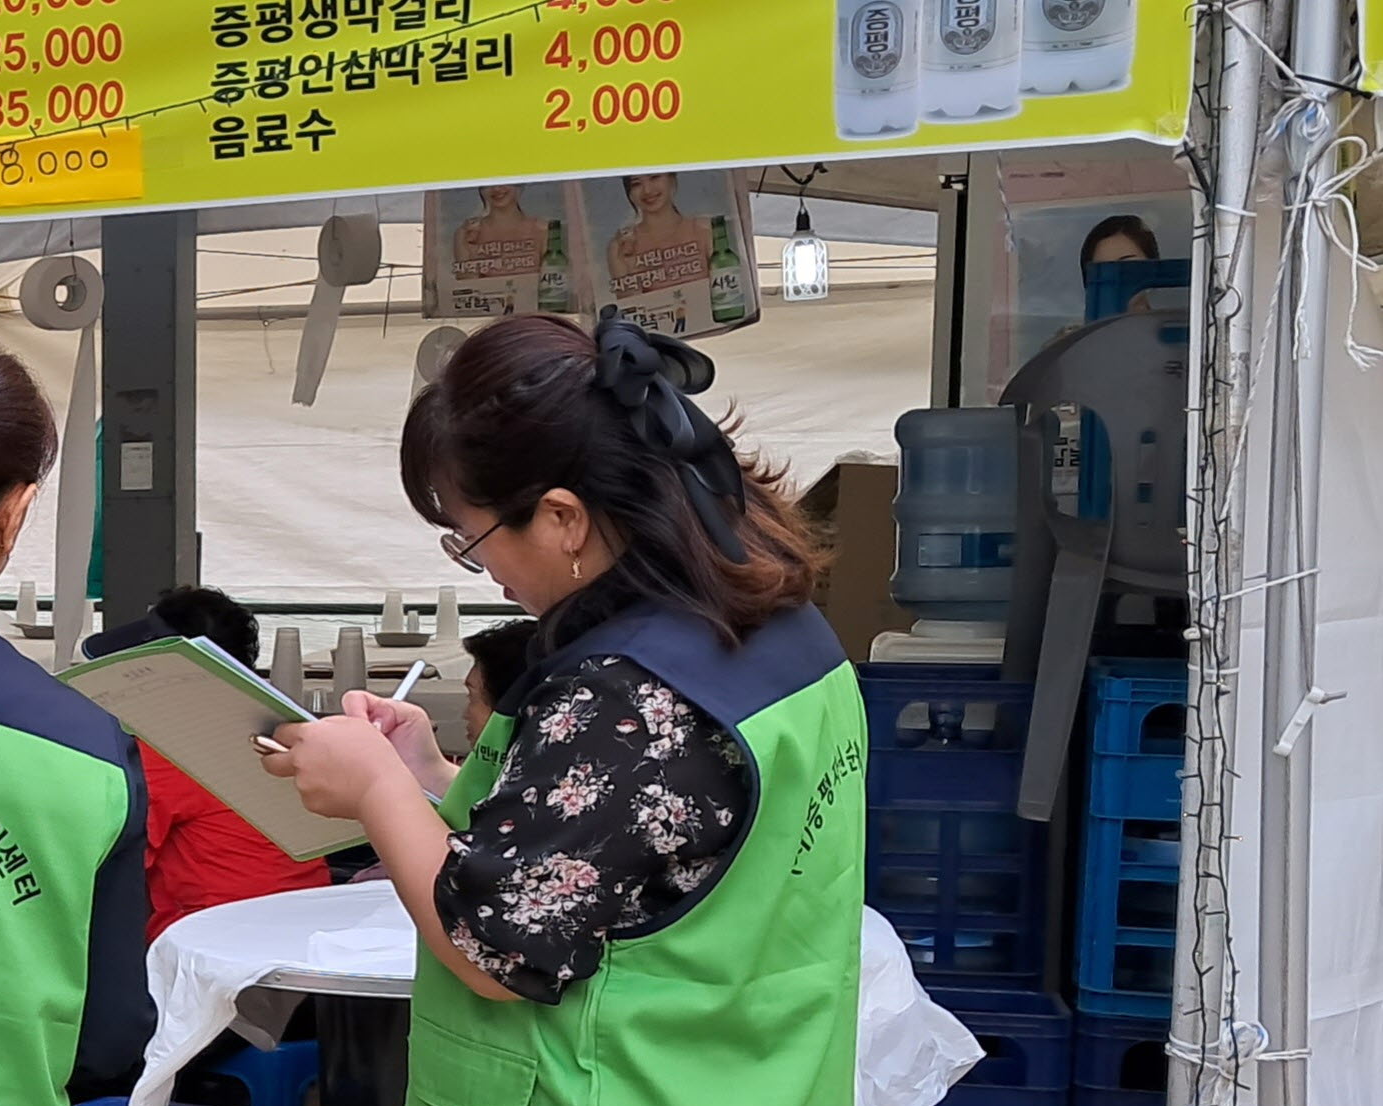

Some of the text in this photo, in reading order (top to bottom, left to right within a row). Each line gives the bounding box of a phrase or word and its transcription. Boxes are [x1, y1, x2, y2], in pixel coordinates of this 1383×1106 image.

[545, 20, 681, 71] 4,000
[545, 80, 681, 132] 2,000
[209, 108, 337, 159] 음료수
[611, 271, 666, 292] 지역경제
